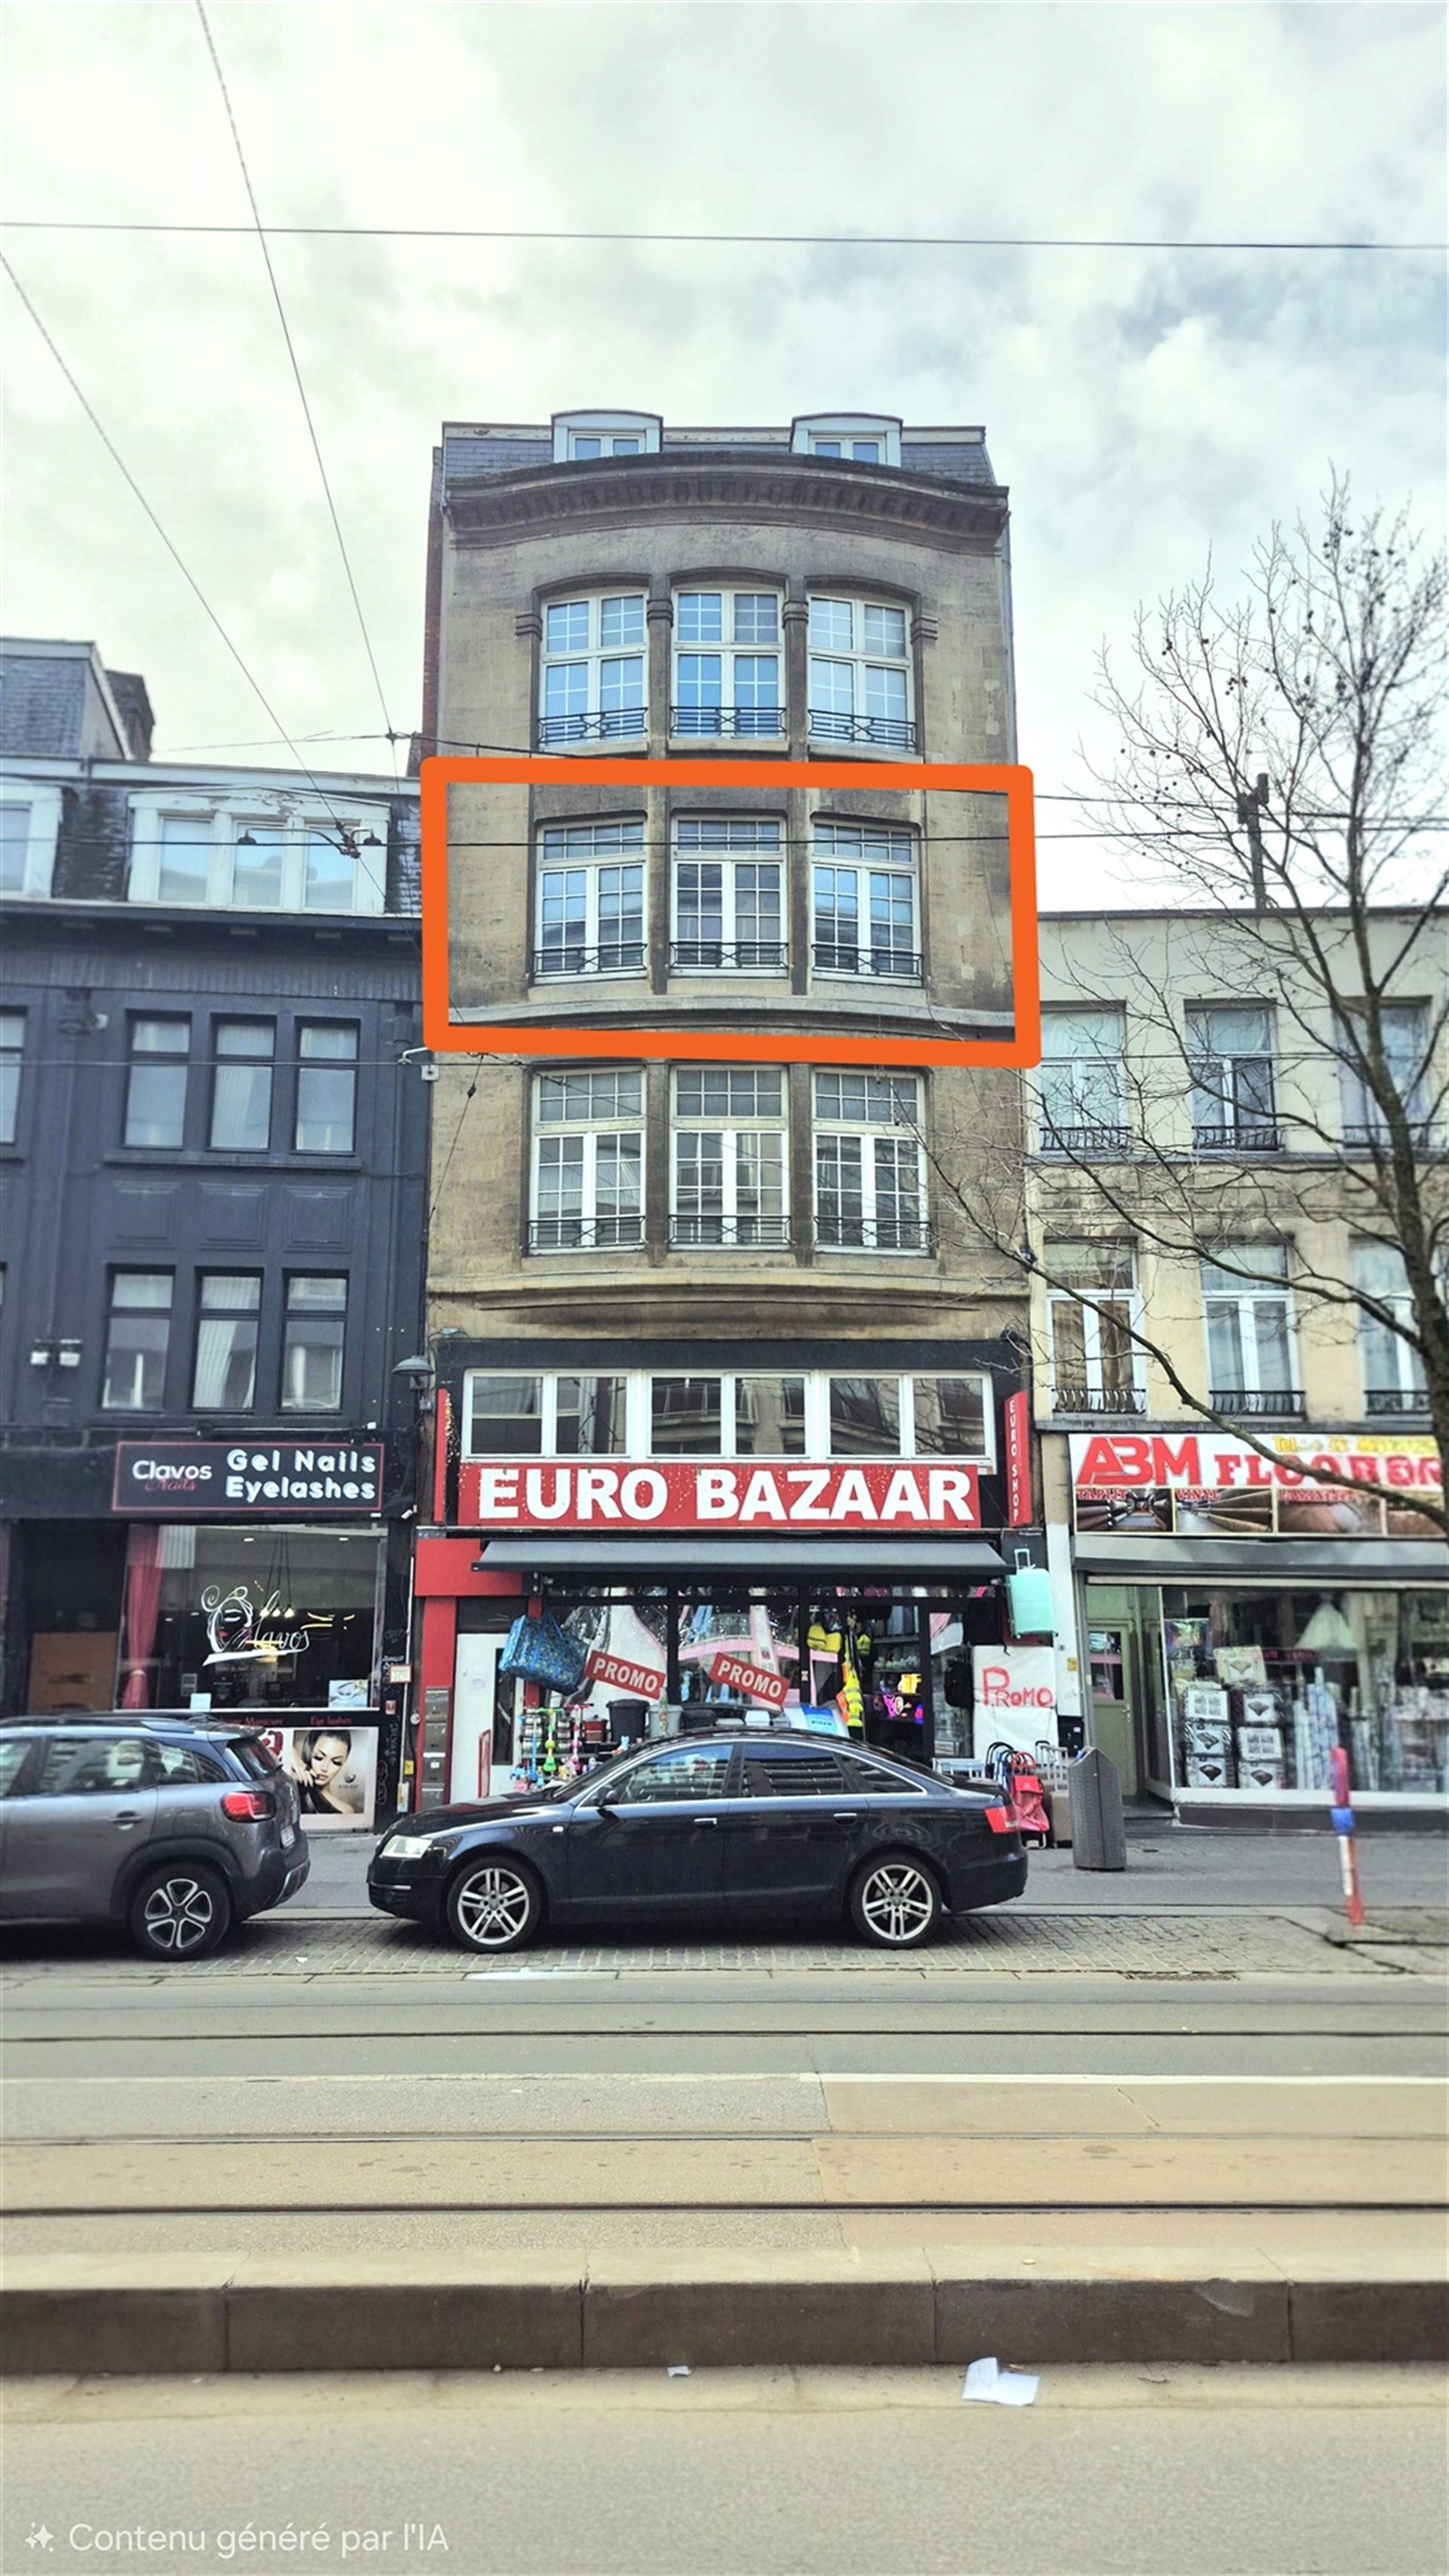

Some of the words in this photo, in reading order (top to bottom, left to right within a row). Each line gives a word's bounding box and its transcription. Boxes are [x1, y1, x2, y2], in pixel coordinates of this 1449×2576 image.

[1009, 1399, 1018, 1457] EURO
[132, 1460, 212, 1480] Clavos
[226, 1448, 281, 1472] Gel
[294, 1450, 376, 1473] Nails
[1075, 1436, 1202, 1486] ABM
[226, 1476, 376, 1503] Eyelashes
[478, 1468, 669, 1520] EURO
[695, 1468, 974, 1521] BAZAAR
[1011, 1463, 1020, 1522] SHOP
[592, 1657, 659, 1692] PROMO
[716, 1660, 783, 1698] PROMO
